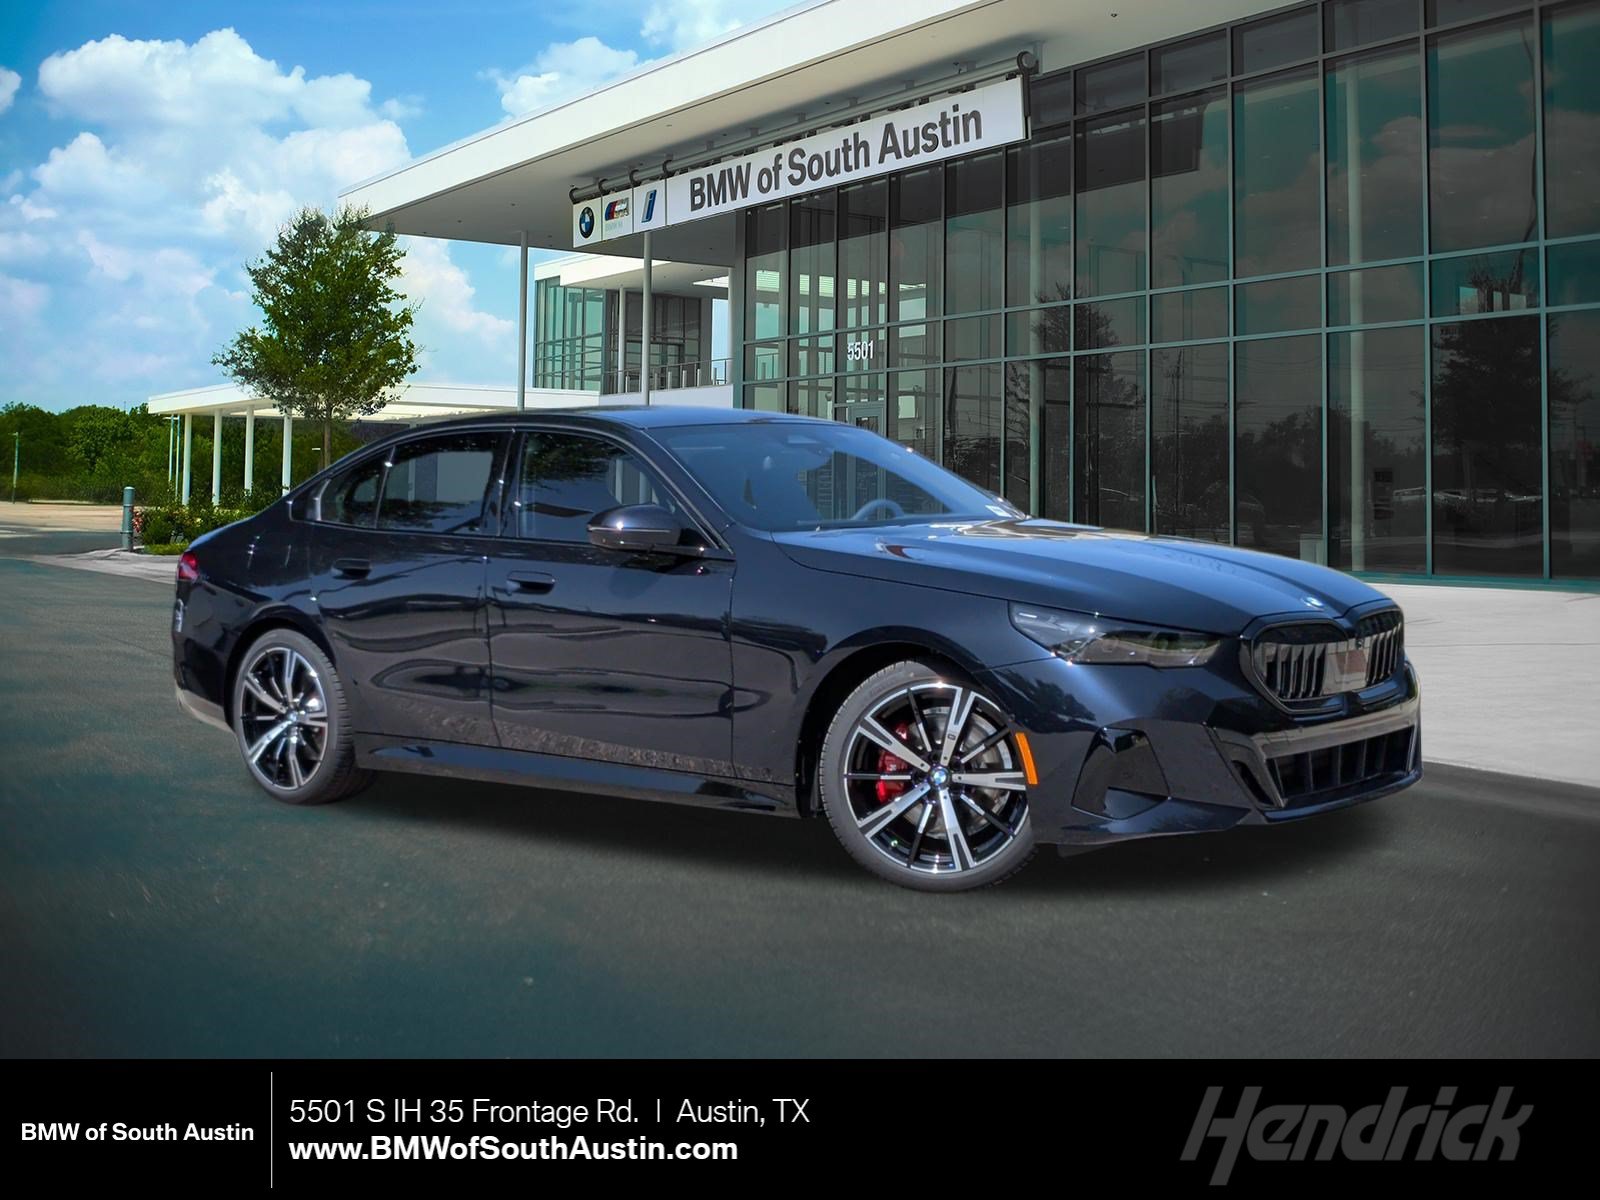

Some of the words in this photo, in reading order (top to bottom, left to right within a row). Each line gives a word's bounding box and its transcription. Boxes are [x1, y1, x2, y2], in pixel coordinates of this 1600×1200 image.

[690, 162, 752, 212] BMW
[757, 153, 782, 194] of
[787, 132, 870, 186] South
[878, 103, 983, 165] Austin
[847, 340, 873, 360] 5501
